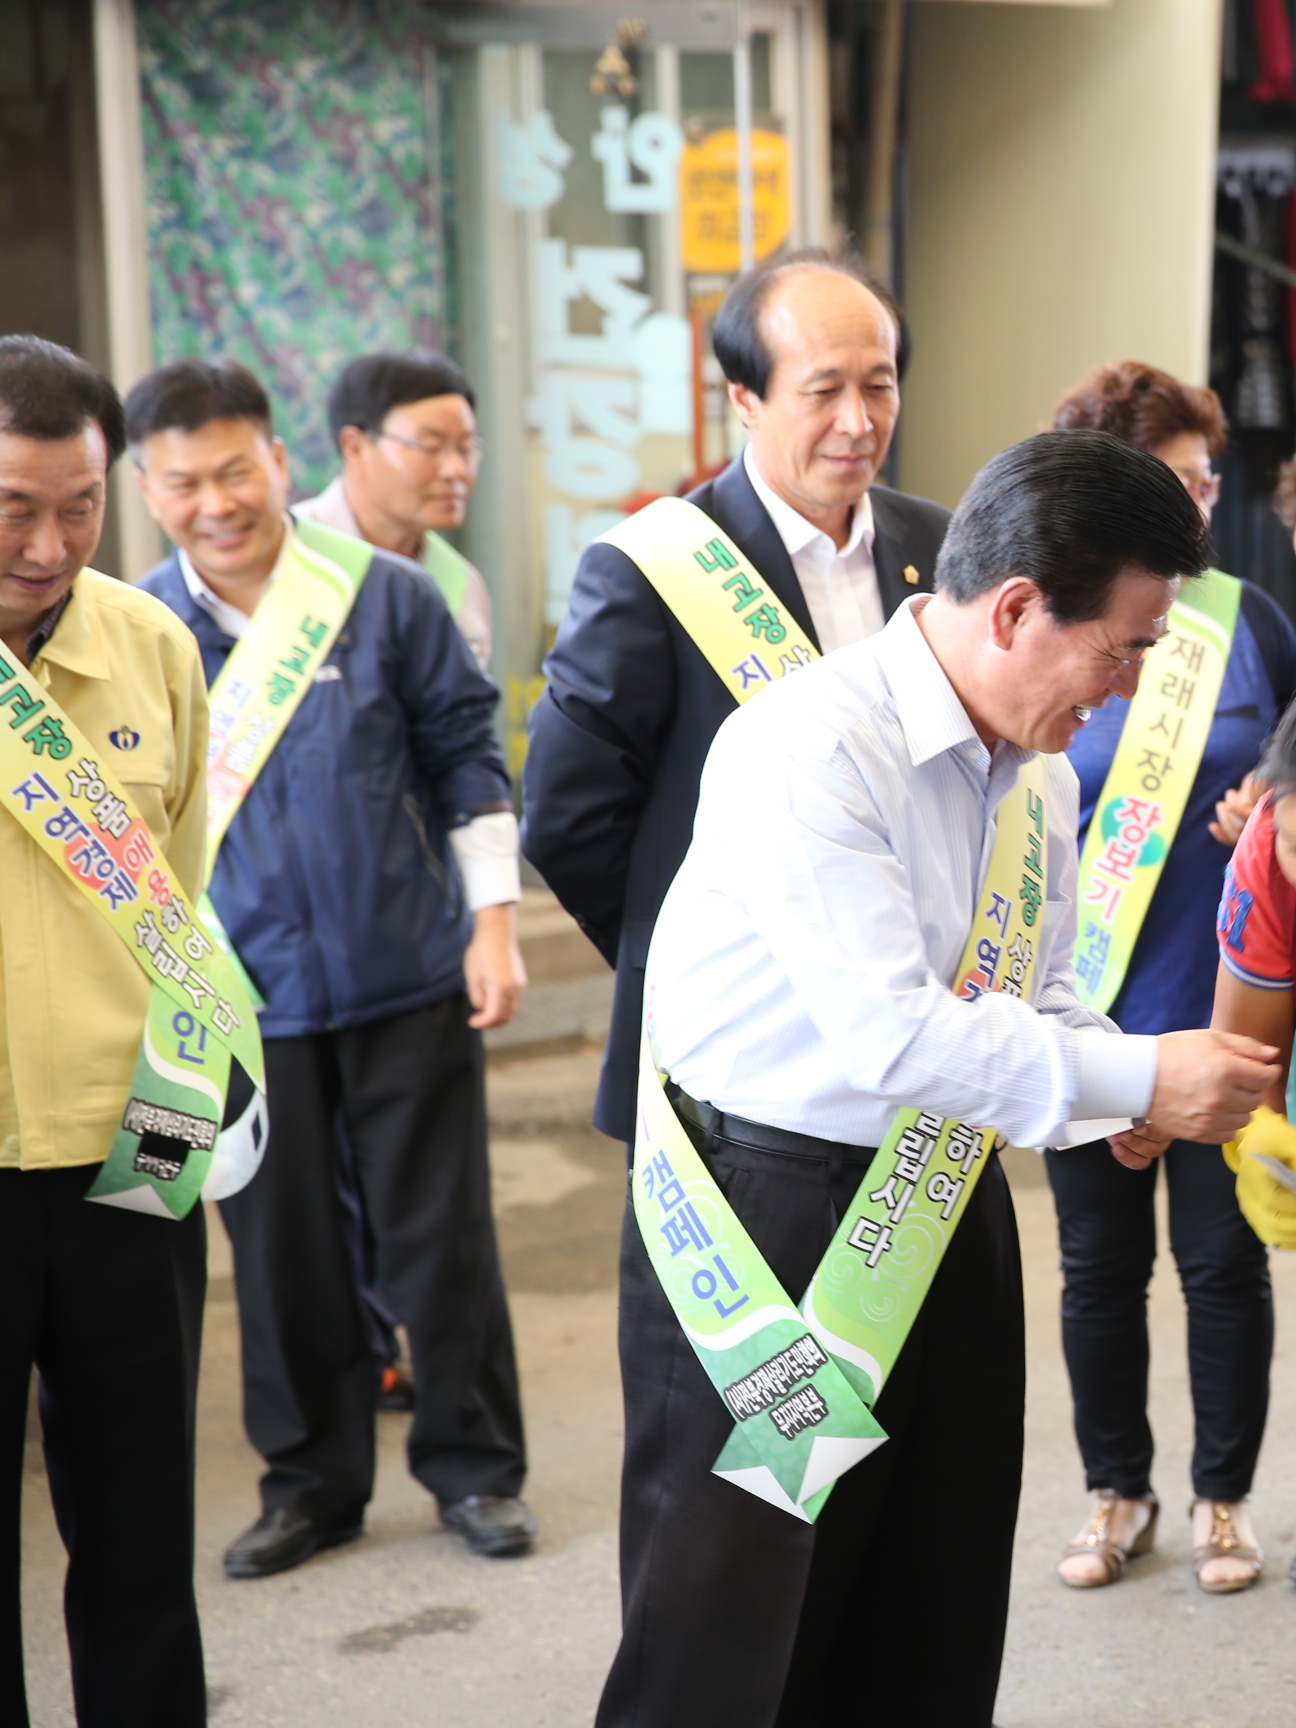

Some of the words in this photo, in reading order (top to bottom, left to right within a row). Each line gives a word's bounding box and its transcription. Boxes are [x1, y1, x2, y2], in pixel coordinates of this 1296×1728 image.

[694, 537, 787, 644] 내고장
[1135, 635, 1206, 793] 재래시장
[11, 771, 139, 912] 지역경제
[133, 909, 241, 1036] 살립시다
[66, 757, 132, 840] 상품
[123, 828, 214, 960] 애용하여
[1019, 787, 1043, 927] 내고장
[1087, 797, 1163, 922] 장보기
[641, 1148, 750, 1320] 캠페인
